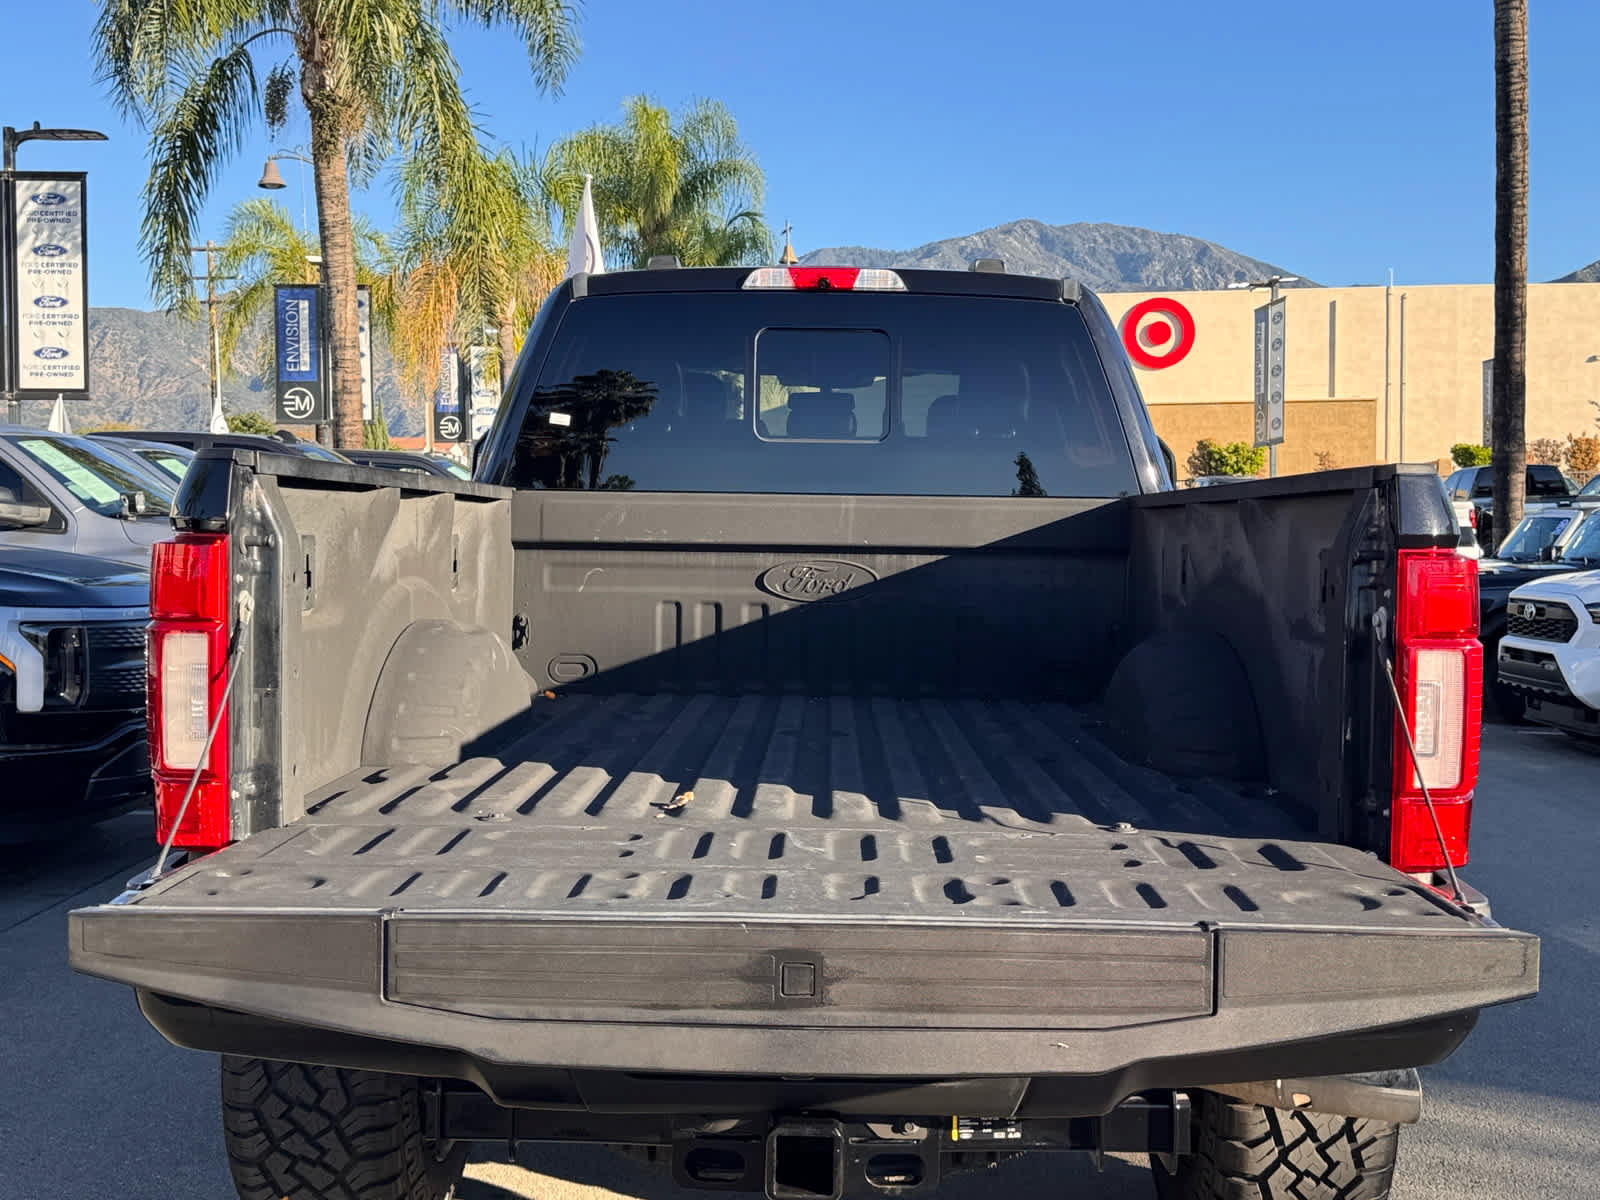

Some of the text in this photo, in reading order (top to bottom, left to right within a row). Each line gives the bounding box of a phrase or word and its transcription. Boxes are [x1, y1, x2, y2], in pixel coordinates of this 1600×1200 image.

[39, 296, 63, 308] Ford
[286, 299, 299, 371] ENVISION
[39, 347, 64, 359] Ford
[783, 564, 856, 593] Ford
